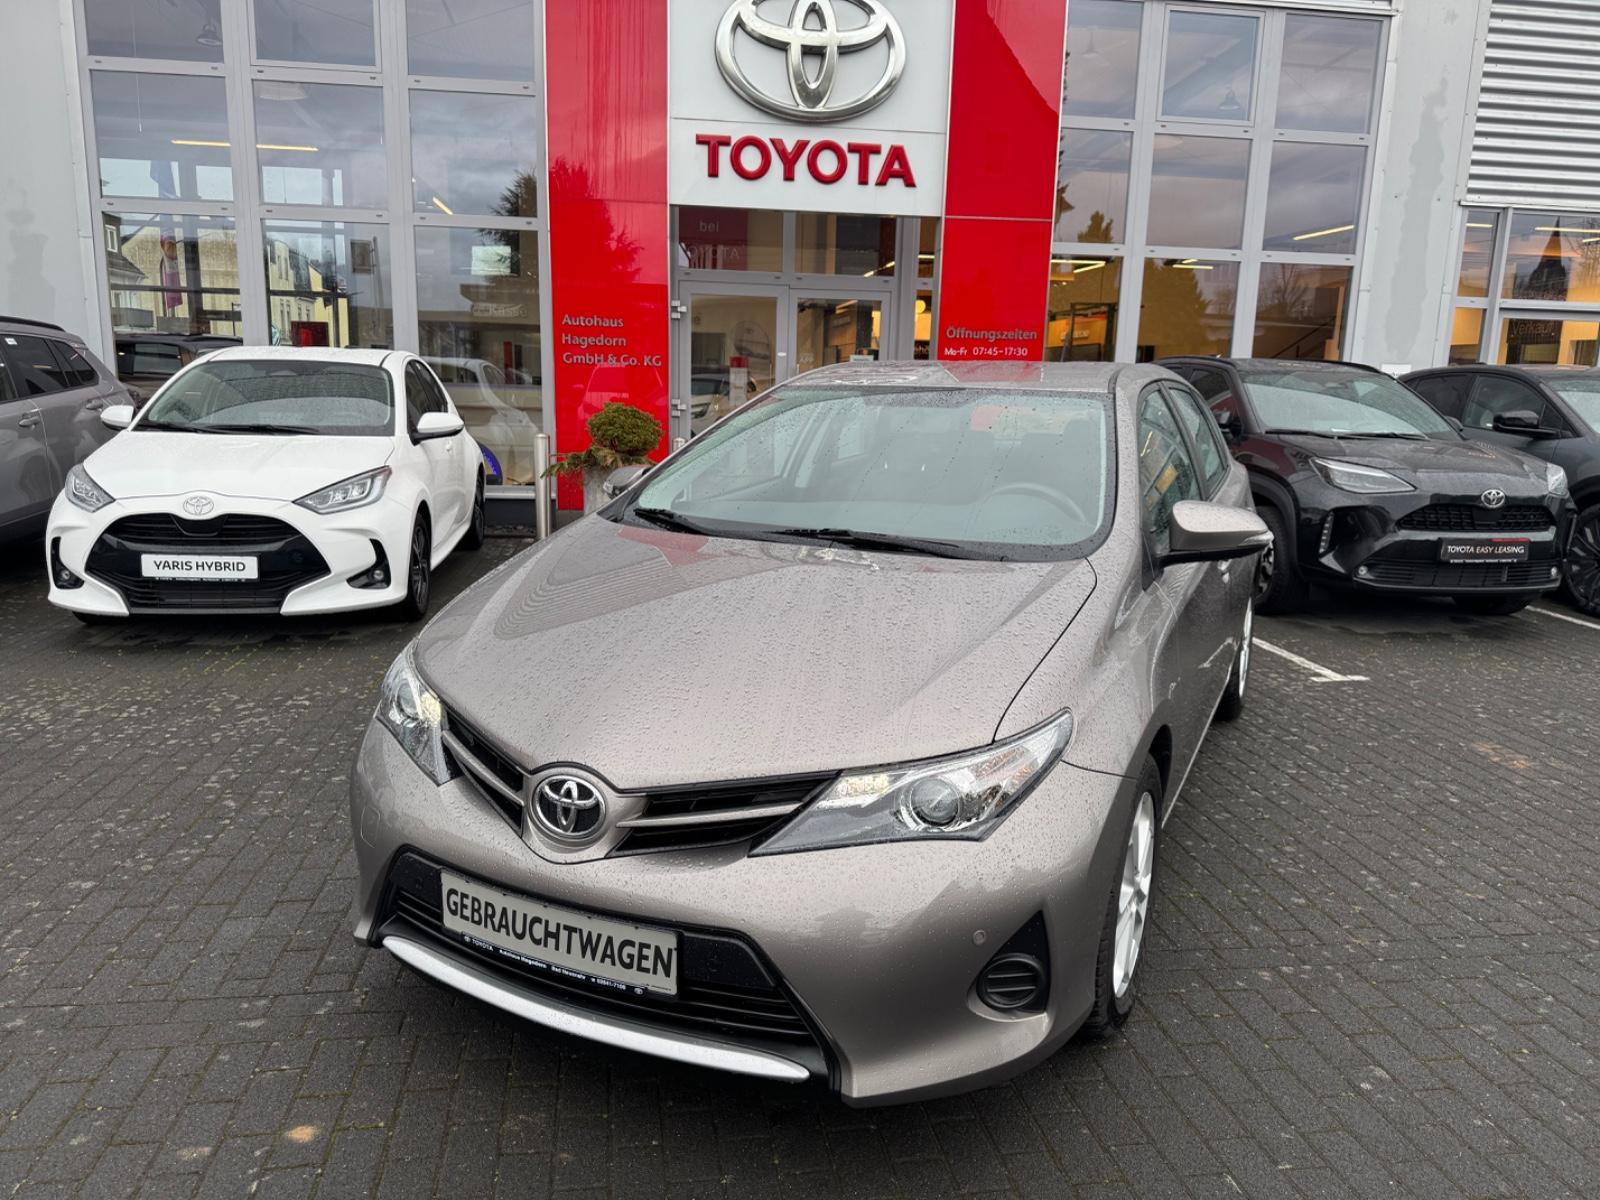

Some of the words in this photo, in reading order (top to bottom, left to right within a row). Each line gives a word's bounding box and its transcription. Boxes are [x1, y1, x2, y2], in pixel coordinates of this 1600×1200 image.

[695, 133, 917, 188] TOYOTA
[698, 219, 719, 232] bei
[562, 314, 624, 327] Autohaus
[946, 325, 1038, 342] Öffnungszeiten
[562, 333, 626, 348] Hagedorn
[944, 347, 967, 356] Mo-Fr
[972, 347, 1028, 356] 07:45-17:30
[562, 352, 604, 365] GmbH
[607, 353, 617, 365] &
[620, 354, 640, 366] Co.
[643, 355, 662, 366] KG
[1447, 545, 1474, 553] TOYOTA
[1476, 546, 1493, 554] EASY
[1494, 545, 1525, 554] LEASING
[153, 560, 193, 571] YARIS
[195, 561, 246, 572] HYBRID
[446, 887, 674, 979] GEBRAUCHTWAGEN
